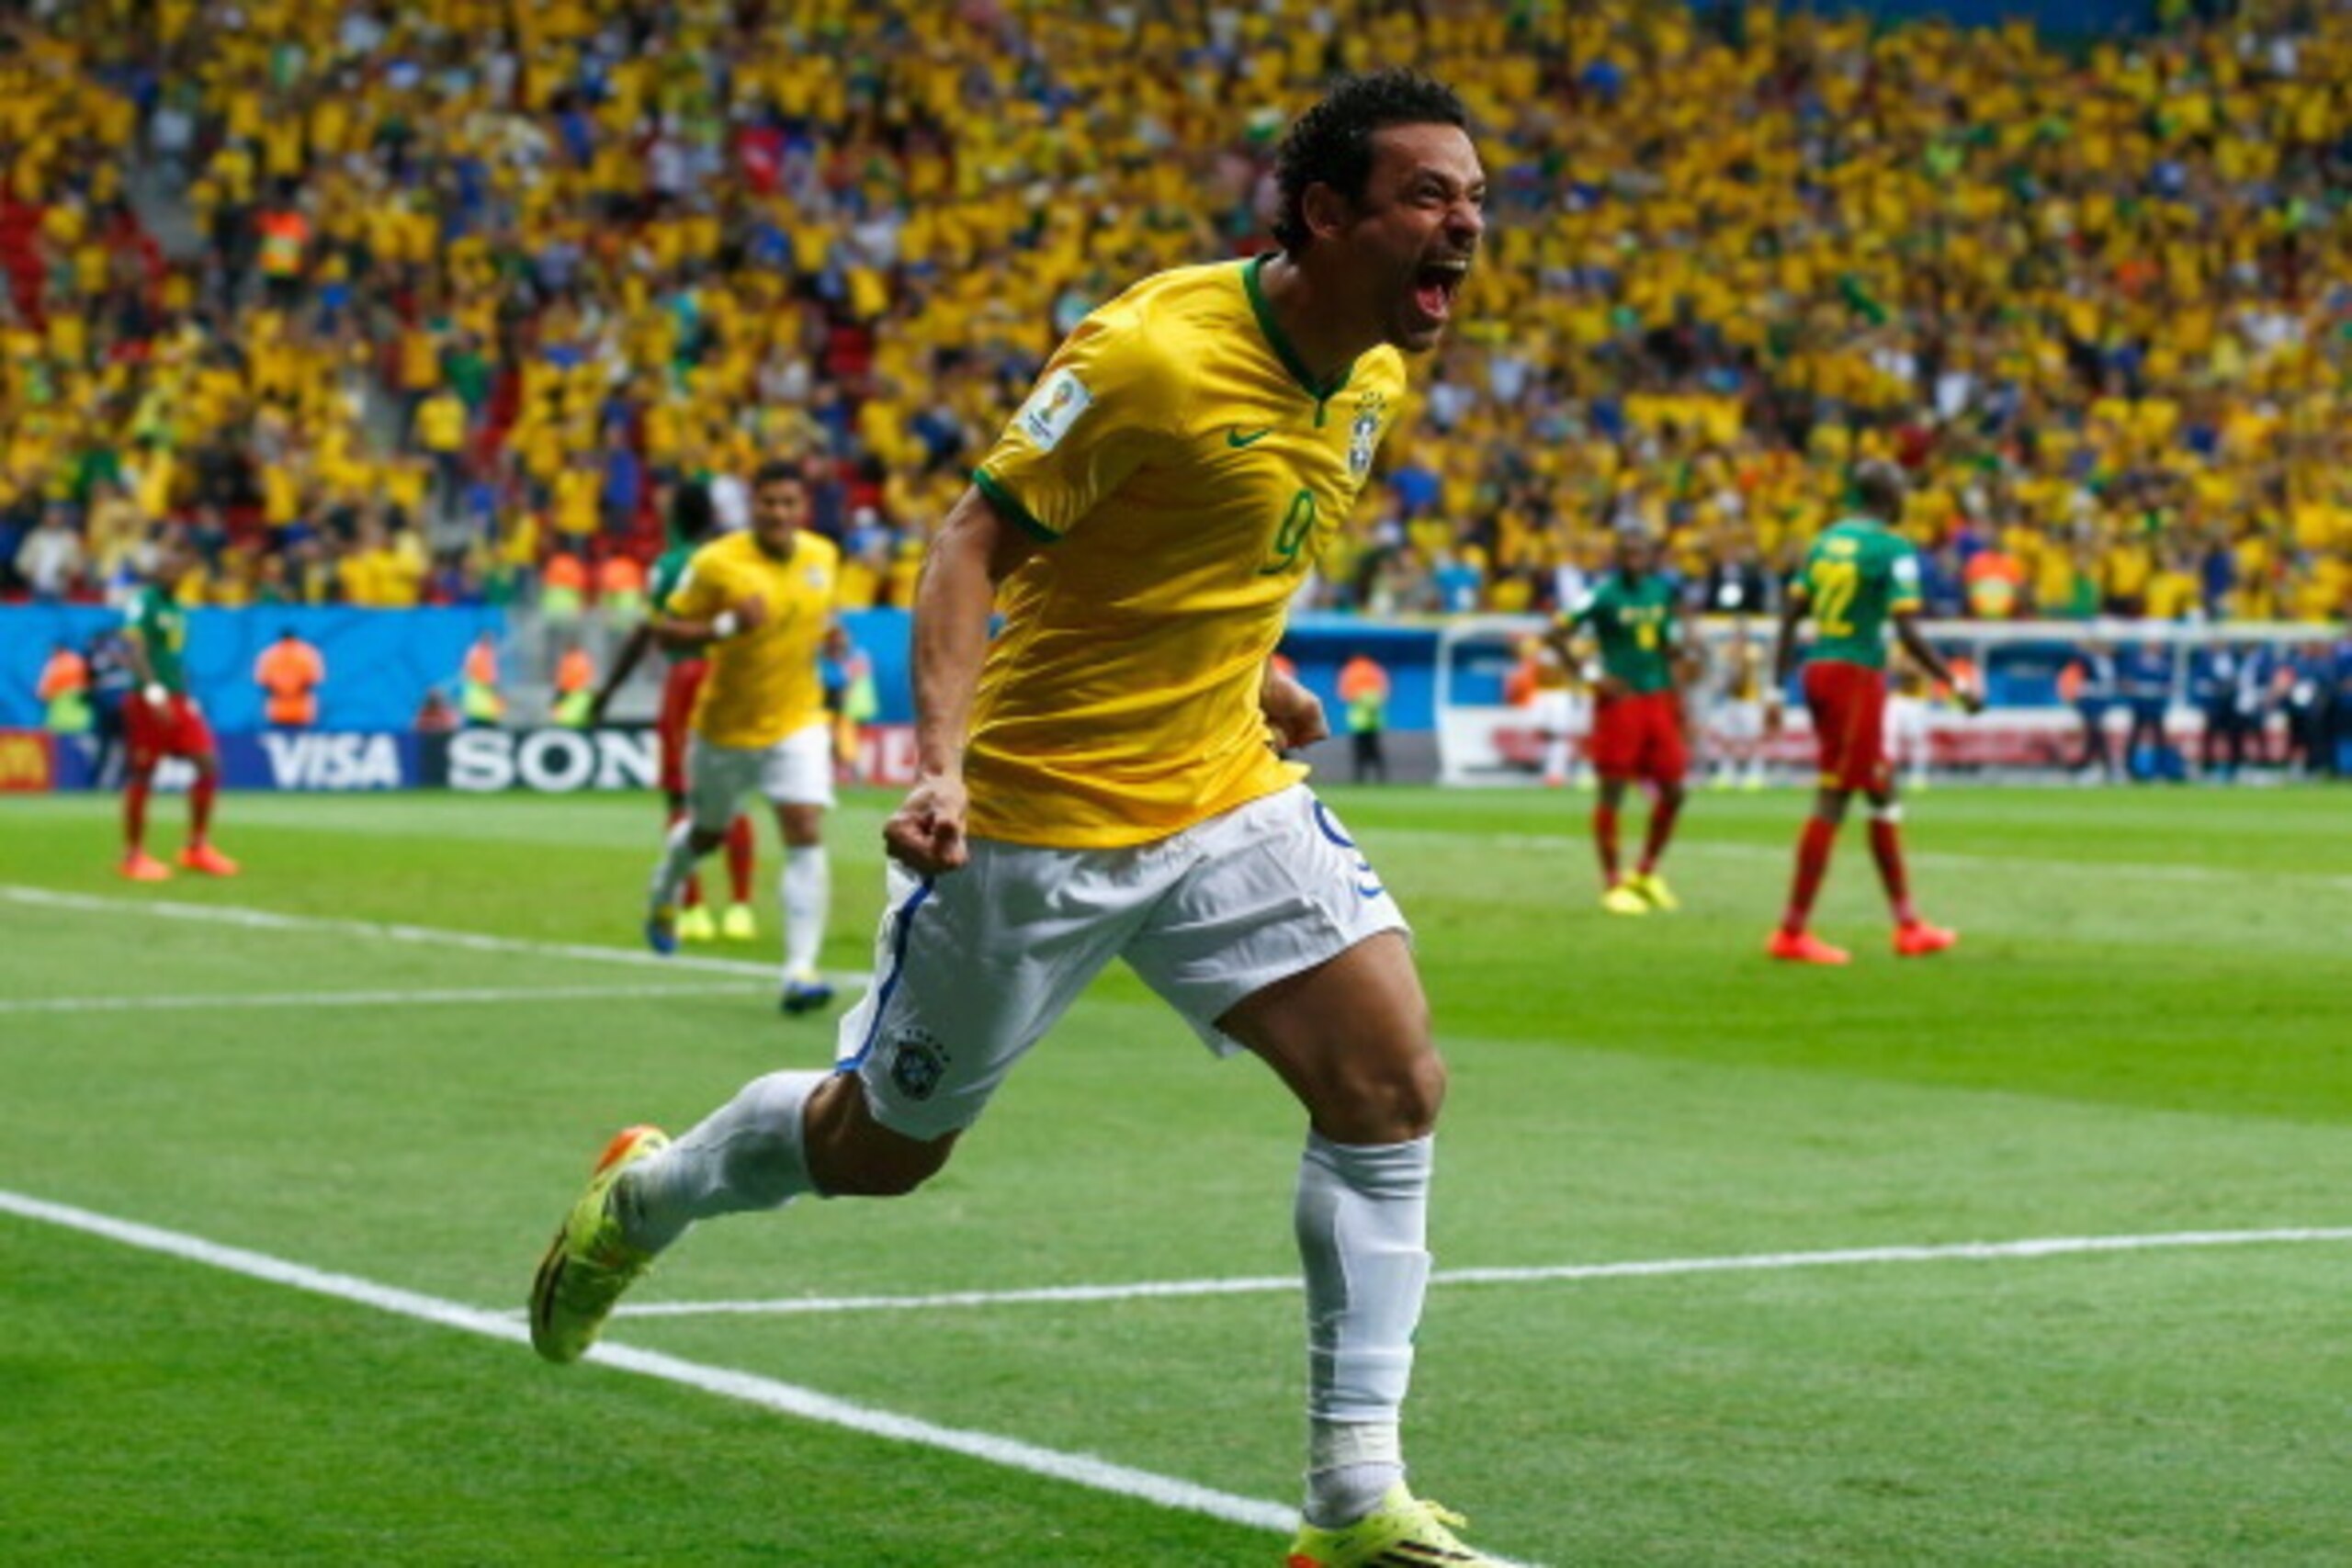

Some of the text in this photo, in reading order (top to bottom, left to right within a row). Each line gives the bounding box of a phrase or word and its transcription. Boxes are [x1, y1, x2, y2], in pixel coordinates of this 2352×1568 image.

[1258, 489, 1315, 576] 9
[257, 731, 401, 788] VISA
[447, 727, 662, 793] SON
